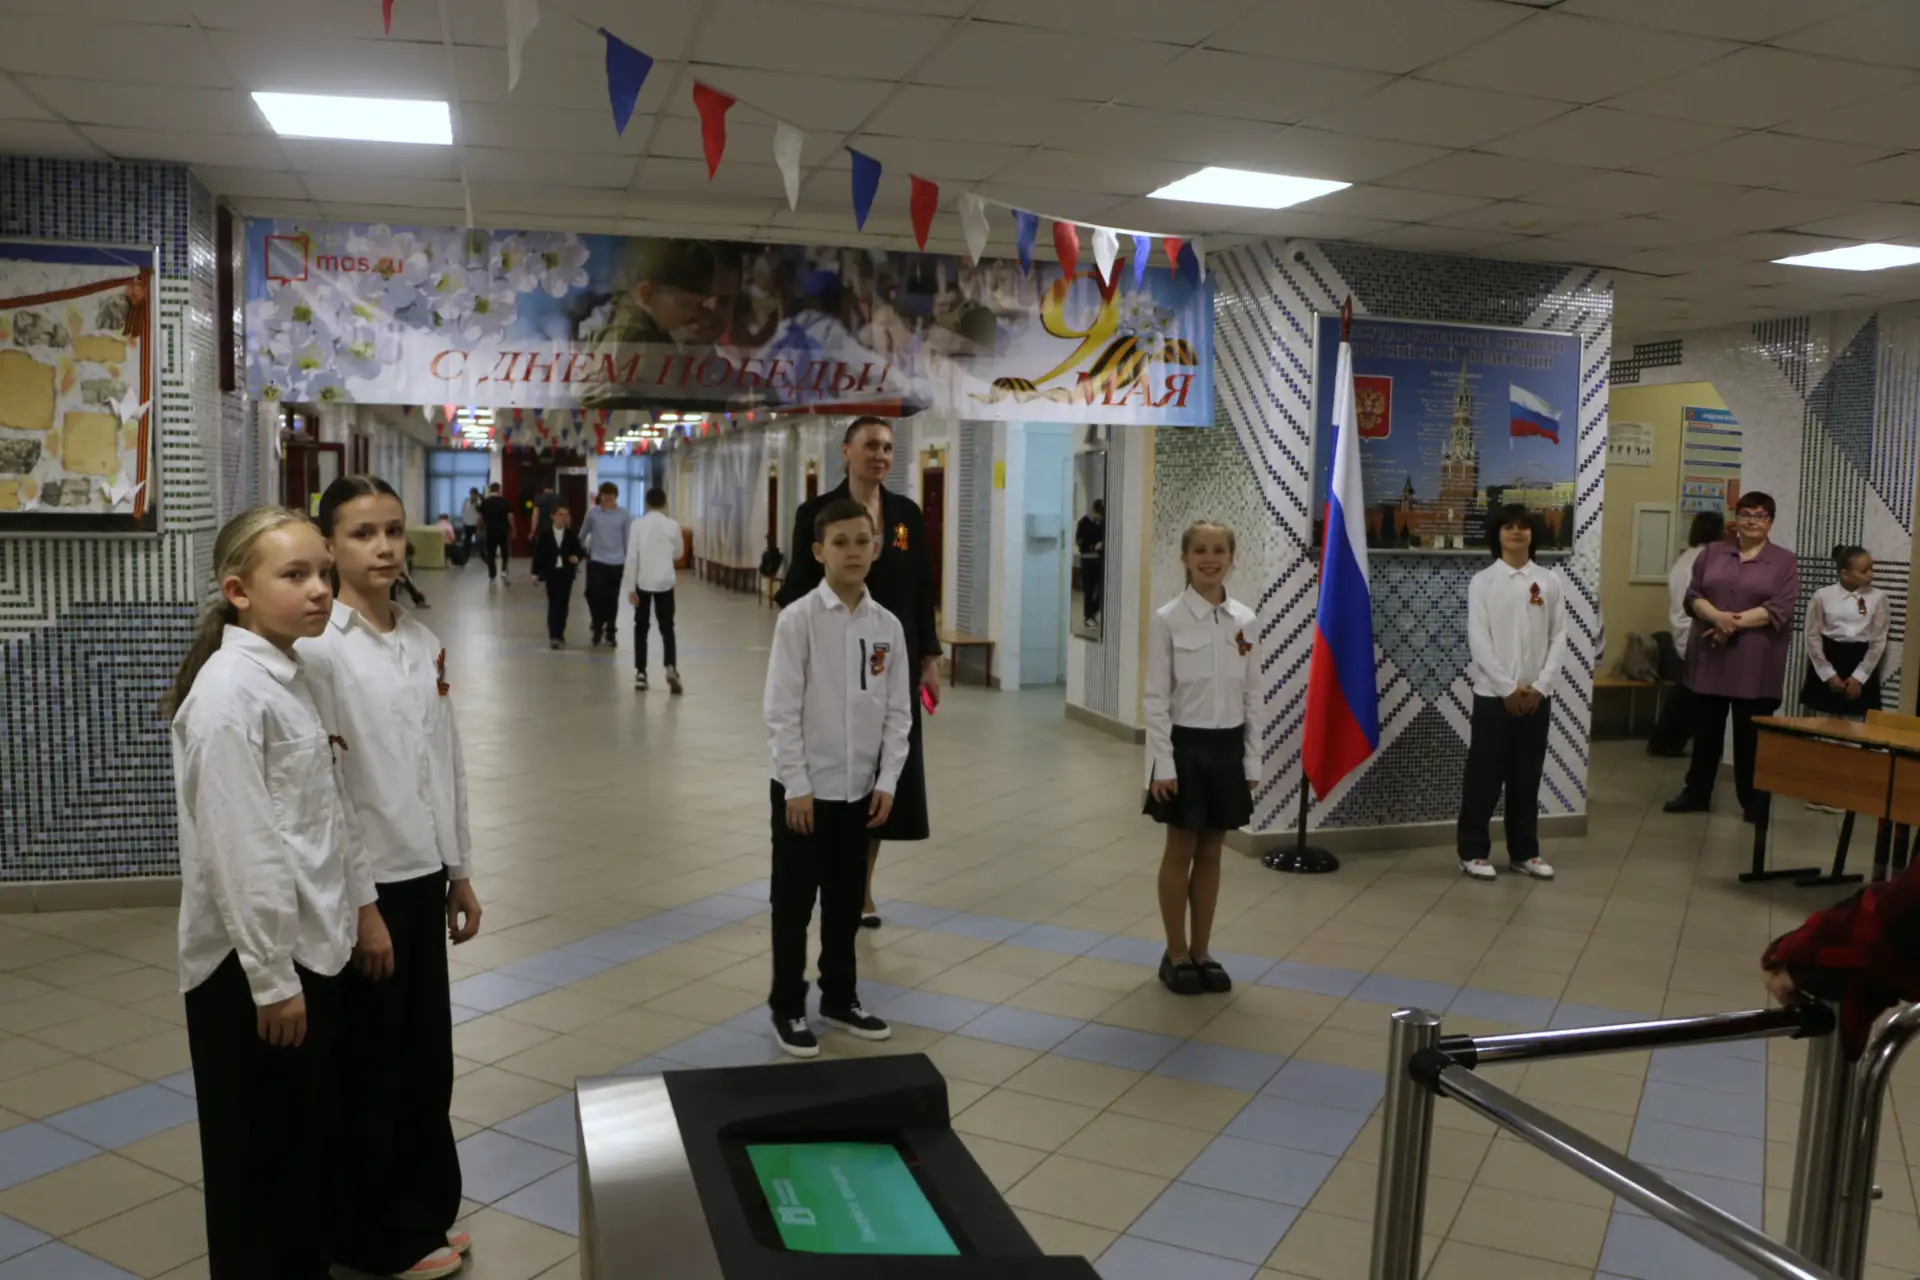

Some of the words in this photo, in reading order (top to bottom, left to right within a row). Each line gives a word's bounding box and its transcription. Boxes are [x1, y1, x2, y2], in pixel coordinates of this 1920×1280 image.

[429, 349, 469, 381] С
[476, 351, 644, 389] ДНЕМ
[656, 354, 890, 399] ПОБЕДЫ!
[1076, 371, 1196, 407] МАЯ
